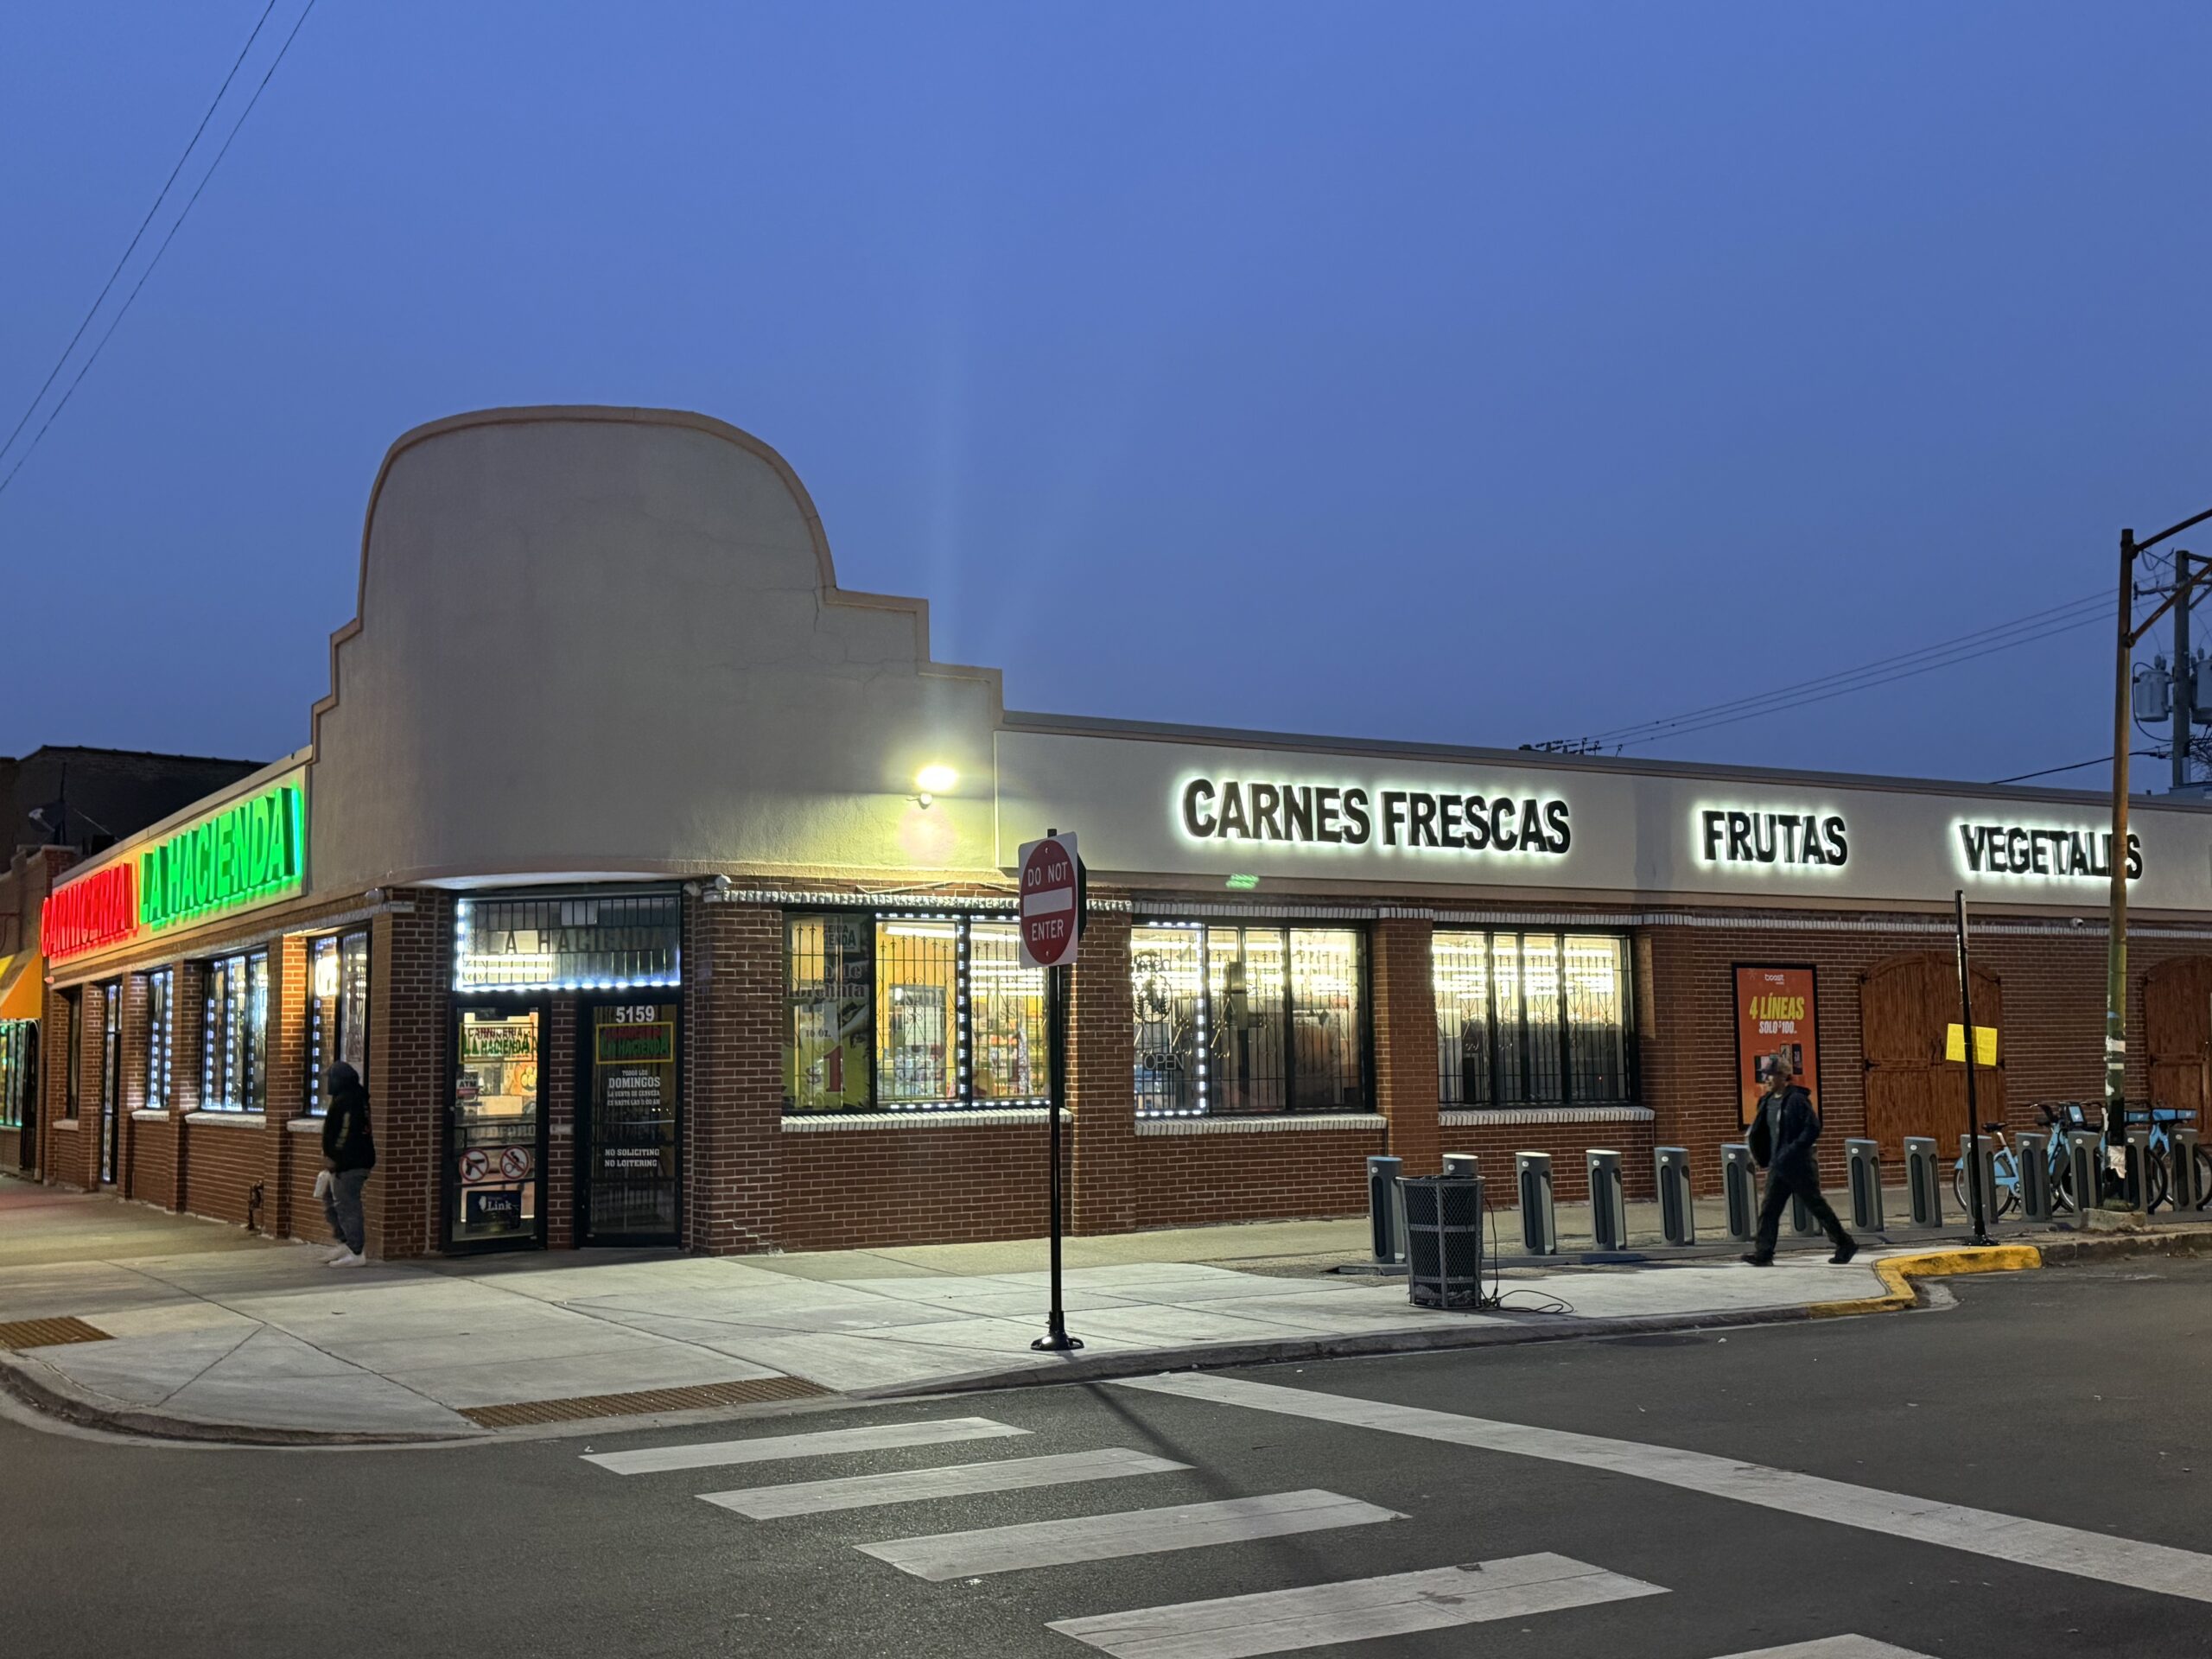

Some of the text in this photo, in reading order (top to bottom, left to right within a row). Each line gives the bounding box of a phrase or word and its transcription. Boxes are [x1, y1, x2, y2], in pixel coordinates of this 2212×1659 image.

[1183, 779, 1571, 854] CARNES FRESCAS
[1702, 810, 1847, 866] FRUTAS
[140, 786, 292, 925] LA HACIENDA
[1027, 861, 1068, 887] DO NOT
[41, 863, 132, 957] CARNICERIA
[1032, 918, 1064, 941] ENTER
[616, 1005, 655, 1023] 5159
[1750, 991, 1805, 1020] 4 LÍNEAS
[1759, 1020, 1778, 1034] SOLO
[1143, 1053, 1185, 1071] OPEN
[608, 1077, 660, 1089] DOMINGOS
[616, 1159, 658, 1167] LOITERING
[487, 1200, 512, 1211] Link
